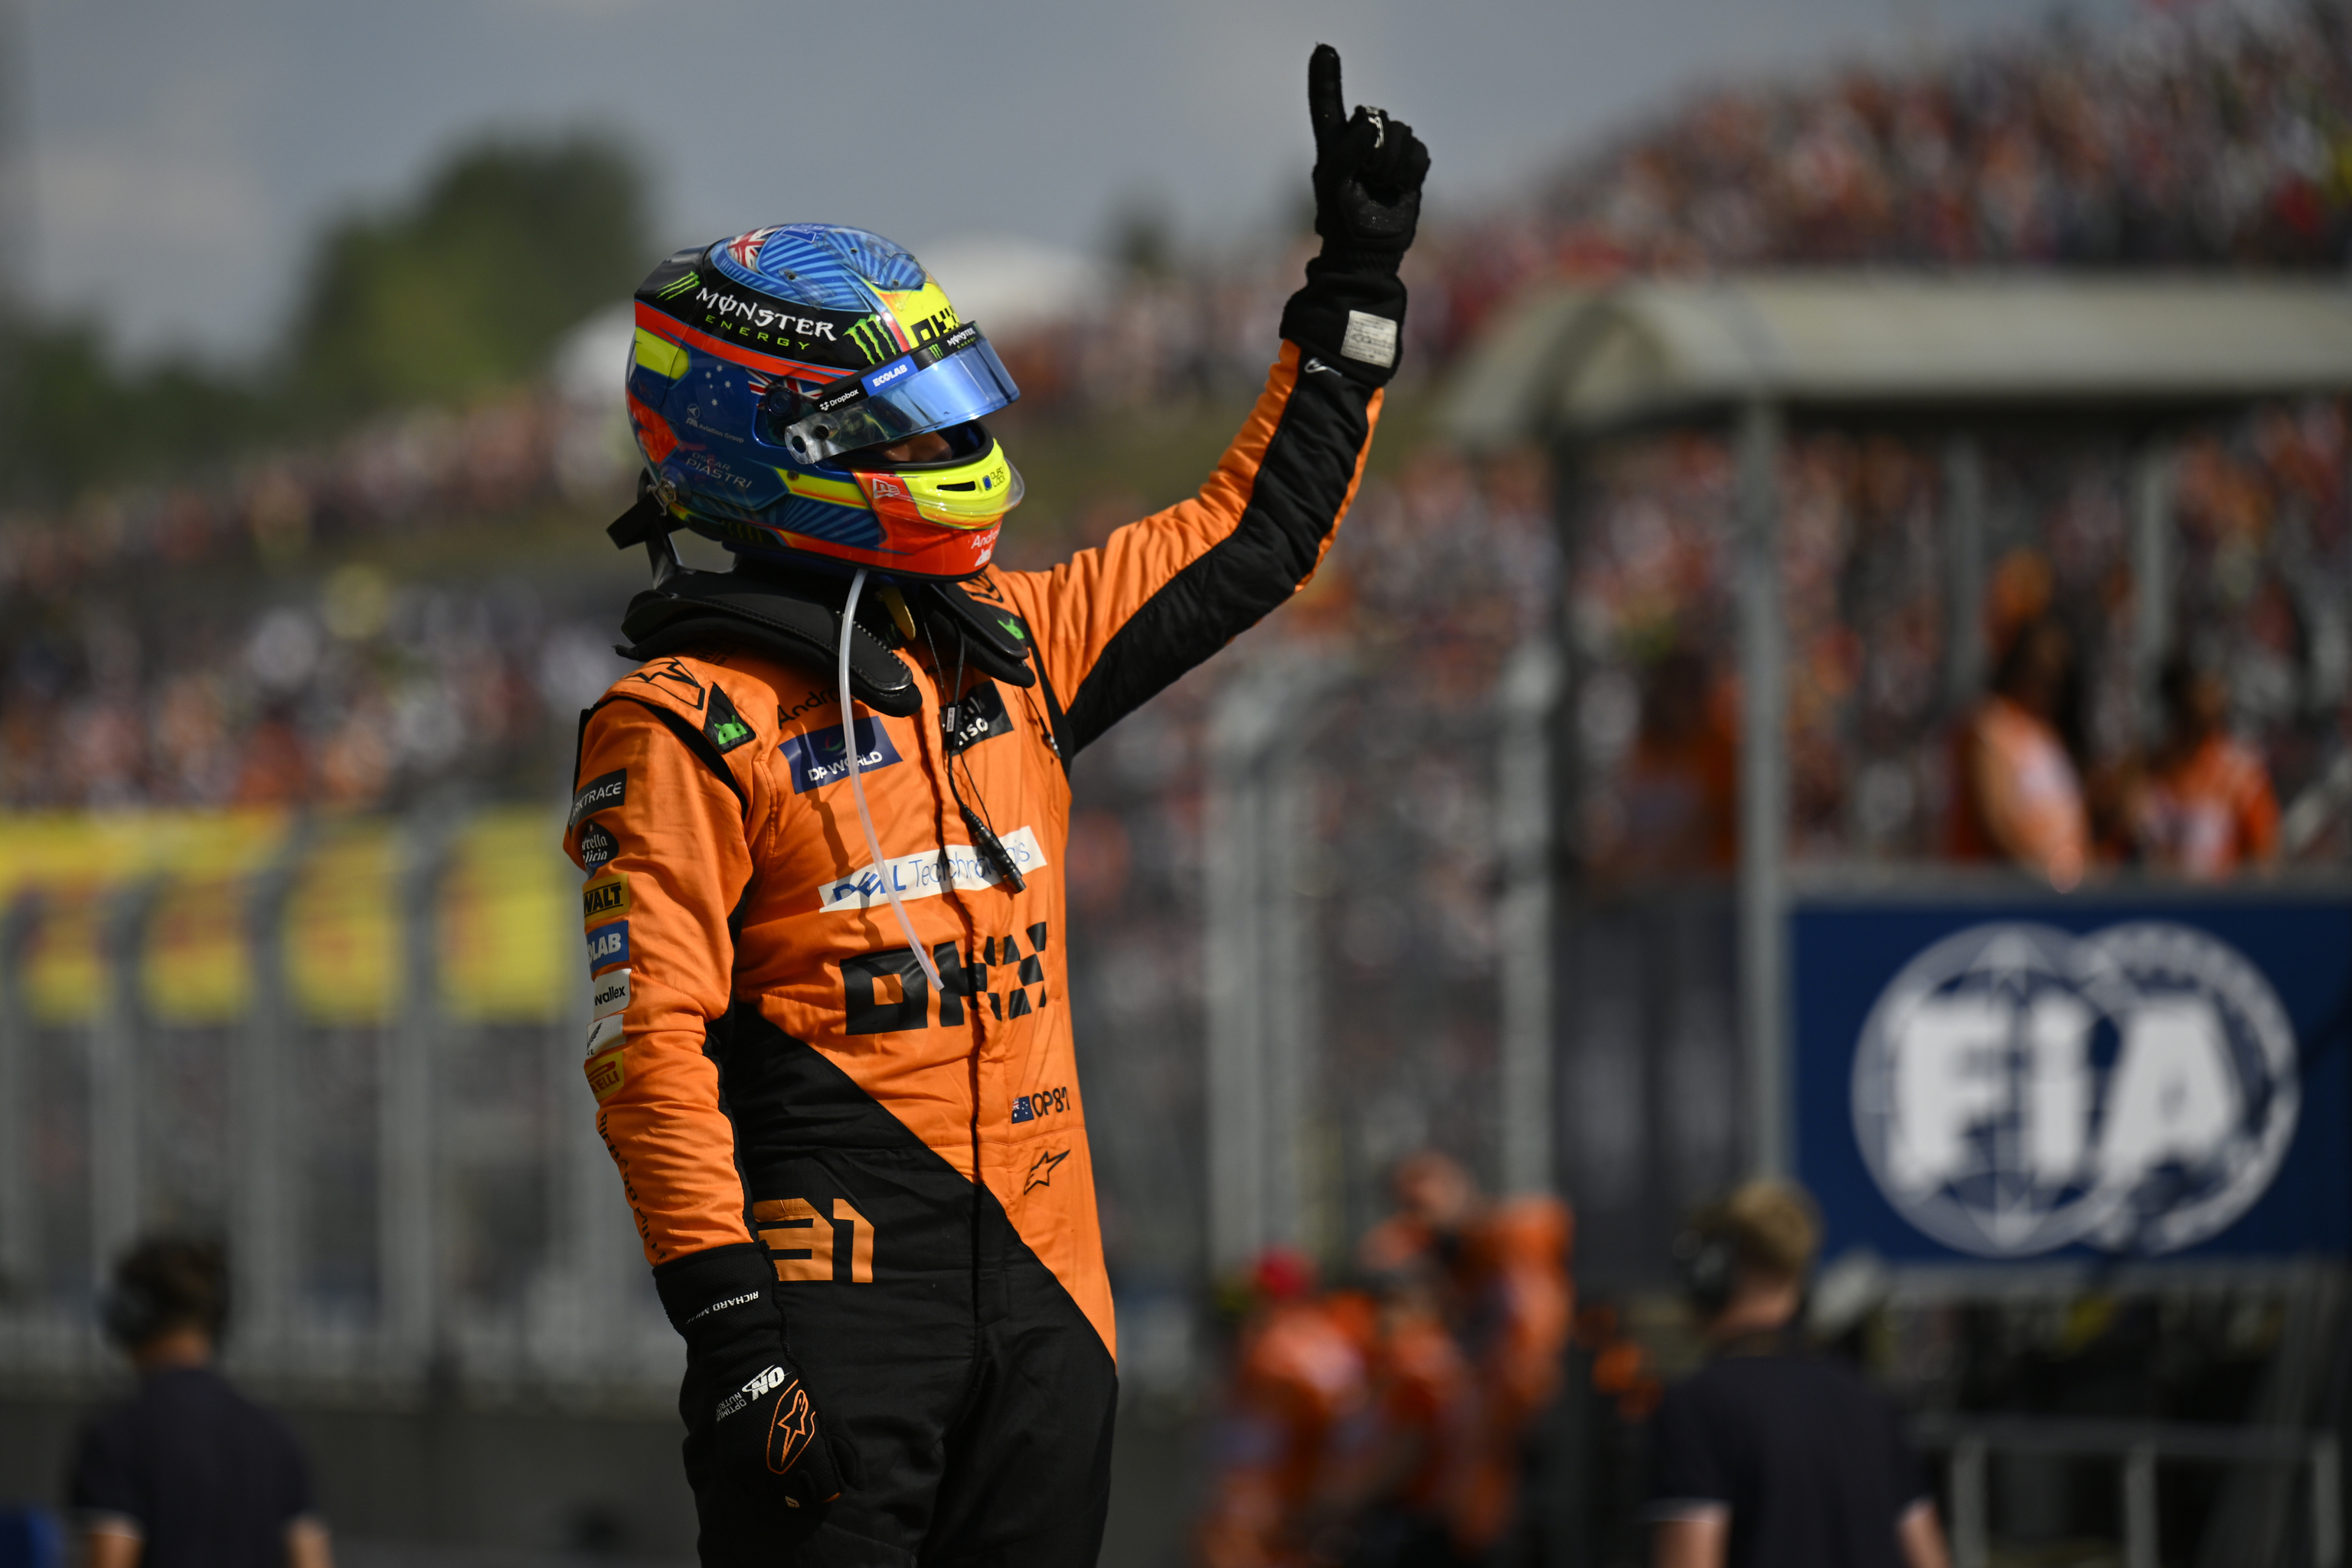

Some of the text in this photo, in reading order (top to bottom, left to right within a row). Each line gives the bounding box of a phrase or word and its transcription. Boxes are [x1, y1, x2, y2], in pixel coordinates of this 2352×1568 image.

[705, 315, 809, 350] ENERGY
[872, 364, 909, 387] ECOLAB
[829, 388, 860, 407] Dropbox
[699, 423, 724, 437] Aviation
[724, 433, 744, 443] Group
[686, 458, 753, 488] PIASTRI
[692, 452, 731, 472] OSCAR
[807, 766, 828, 782] DP
[584, 884, 622, 915] WALT
[1032, 1086, 1070, 1118] OP81
[1883, 993, 2242, 1192] FIA
[712, 1291, 760, 1312] RICHARD
